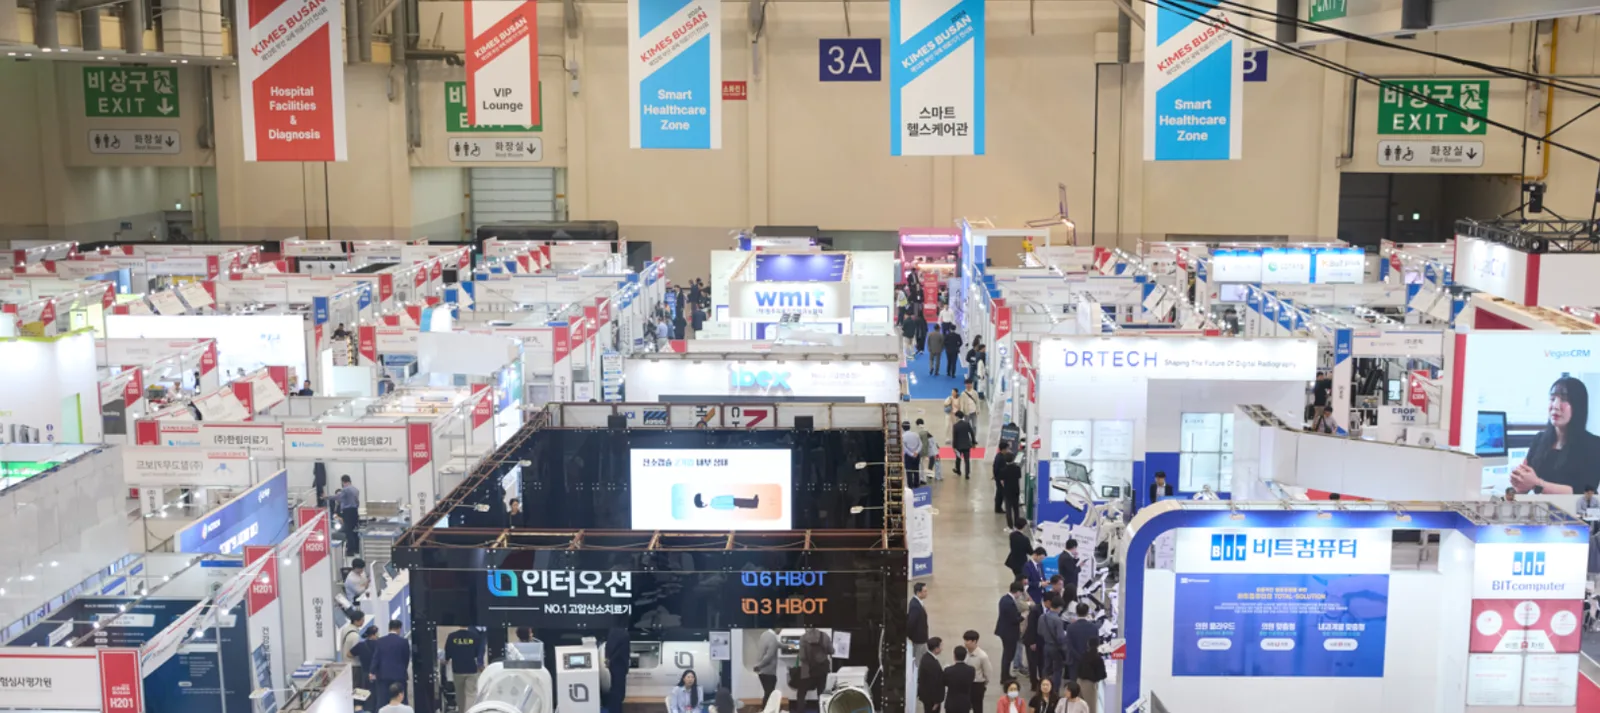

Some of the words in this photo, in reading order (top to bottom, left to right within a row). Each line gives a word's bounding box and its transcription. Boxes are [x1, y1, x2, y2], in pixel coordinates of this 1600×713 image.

[251, 24, 287, 56] KIMES
[640, 36, 673, 62] KIMES
[672, 11, 708, 40] BUSAN
[901, 41, 935, 69] KIMES
[934, 14, 972, 45] BUSAN
[827, 46, 873, 75] 3A
[1157, 43, 1192, 71] KIMES
[88, 71, 148, 92] 비상구
[270, 86, 314, 98] Hospital
[493, 87, 512, 97] VIP
[657, 89, 693, 101] Smart
[1383, 84, 1454, 108] 비상구
[98, 97, 145, 113] EXIT
[269, 100, 317, 111] Facilities
[482, 100, 524, 112] Lounge
[643, 104, 706, 115] Healthcare
[1174, 99, 1212, 110] Smart
[918, 106, 956, 120] 스마트
[289, 115, 297, 125] &
[660, 119, 691, 131] Zone
[1159, 114, 1227, 126] Healthcare
[1393, 113, 1448, 131] EXIT
[268, 128, 321, 142] Diagnosis
[906, 122, 969, 138] 헬스케어관
[1176, 130, 1209, 142] Zone
[134, 134, 162, 144] 화장실
[495, 141, 524, 151] 화장실
[1430, 145, 1463, 156] 화장실
[755, 288, 825, 307] wmit
[1063, 350, 1158, 368] DRTECH
[1164, 359, 1190, 368] Shaping
[1204, 359, 1225, 367] Future
[1235, 359, 1256, 369] Digital
[1257, 359, 1297, 369] Radiography
[213, 435, 269, 445] (주)한림의료기
[337, 436, 392, 446] (주)한림의료기
[1211, 539, 1247, 561] BIT
[1253, 538, 1358, 560] 비트컴퓨터
[1513, 556, 1546, 576] BIT
[522, 570, 633, 598] 인터오션
[759, 571, 772, 587] 6
[776, 571, 827, 587] HBOT
[253, 585, 273, 594] H201
[1491, 580, 1566, 592] BITcomputer
[544, 604, 567, 614] NO.1
[568, 603, 632, 615] 고압산소치료기
[759, 599, 772, 614] 3
[776, 599, 828, 614] HBOT
[110, 697, 133, 708] H201
